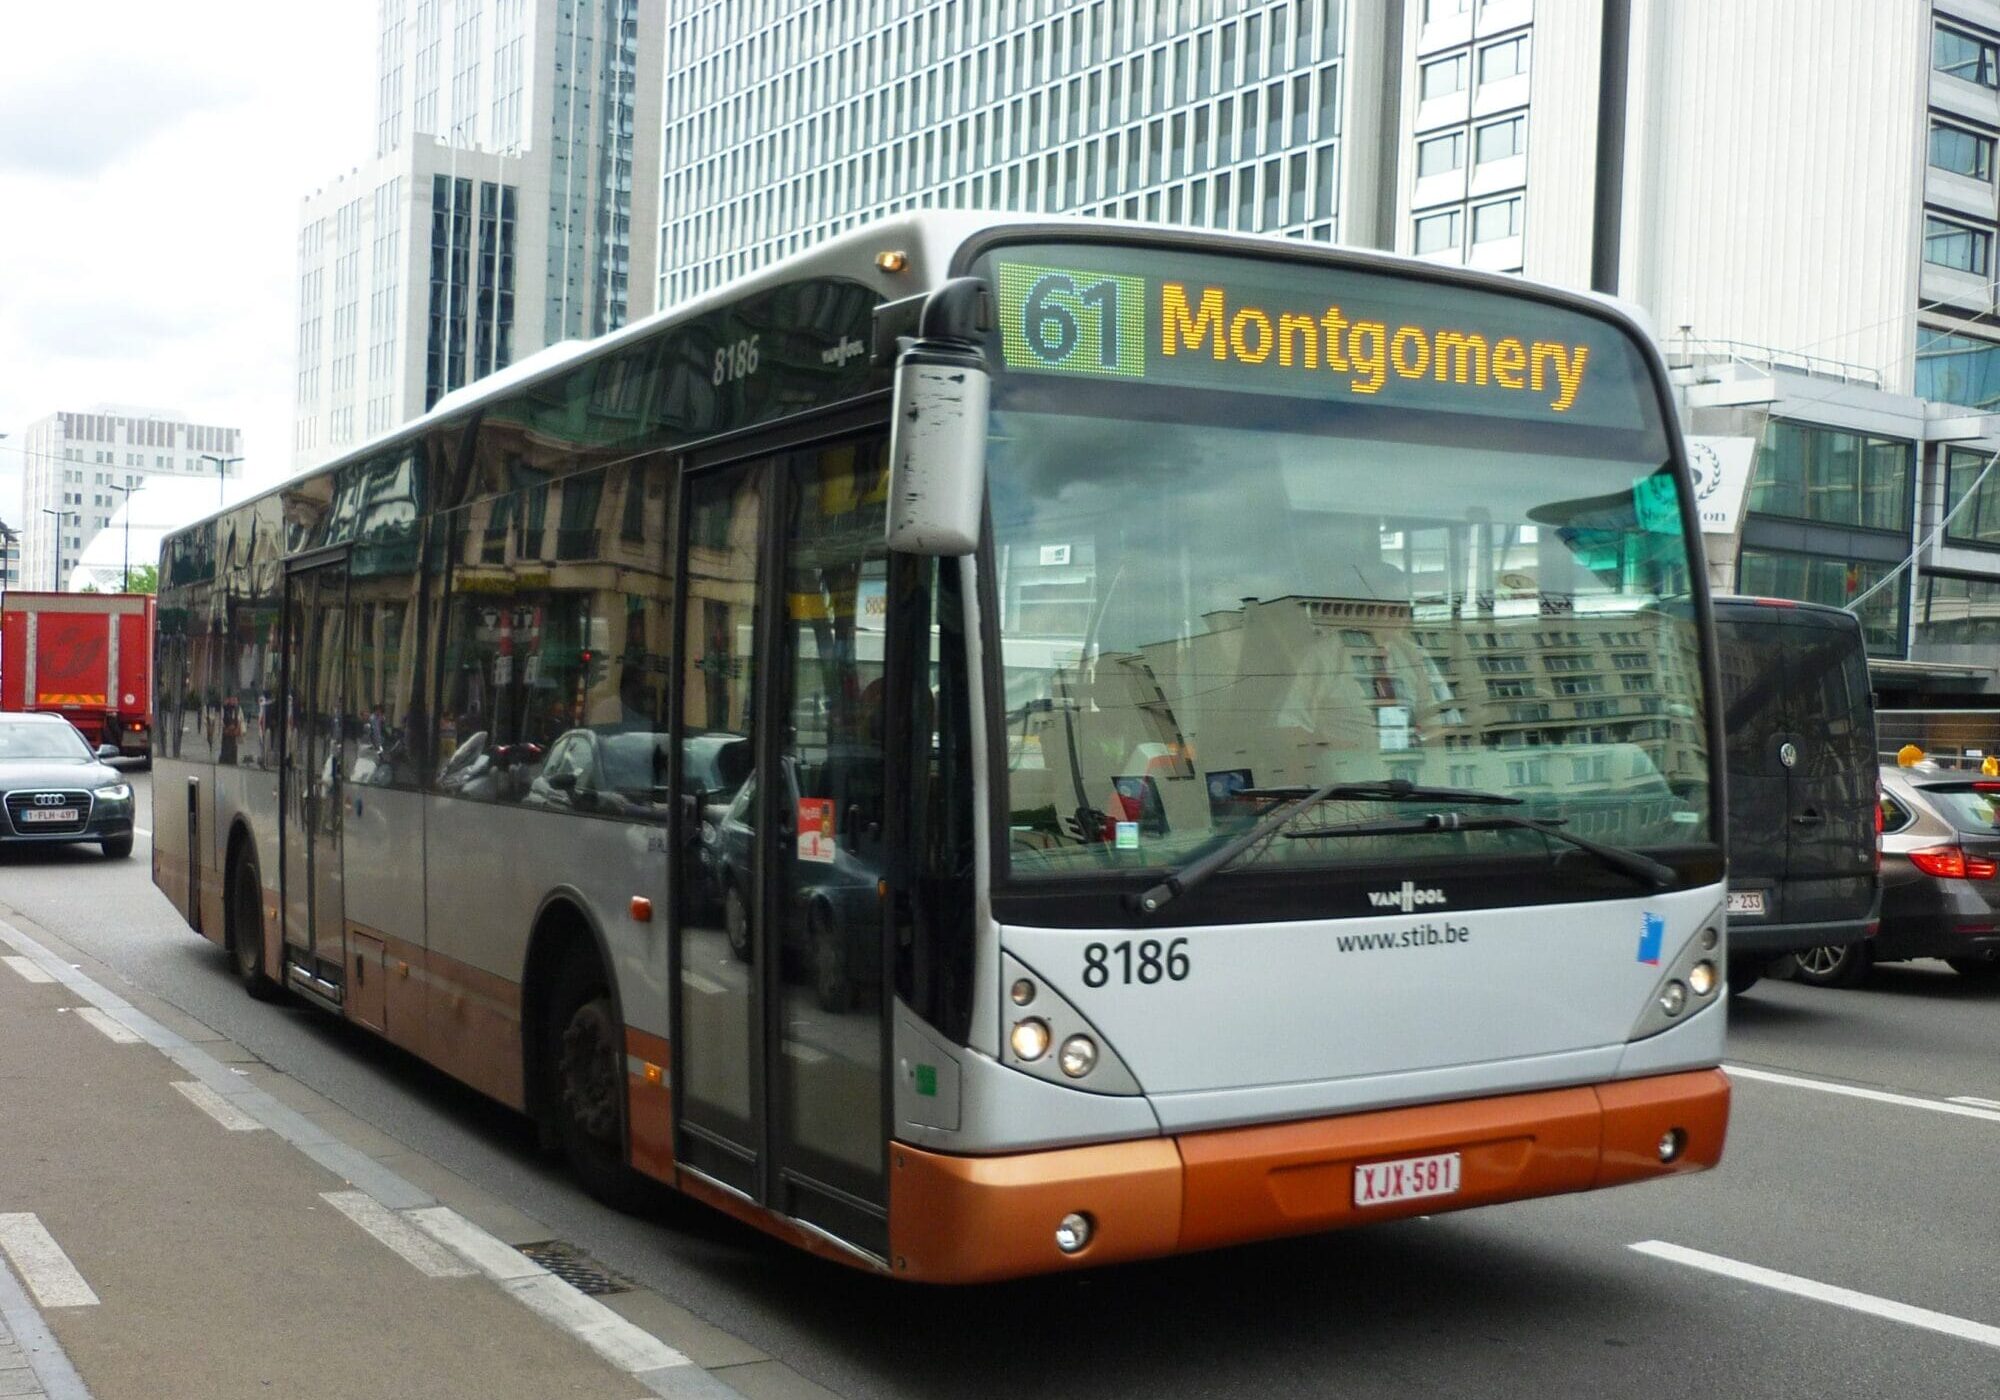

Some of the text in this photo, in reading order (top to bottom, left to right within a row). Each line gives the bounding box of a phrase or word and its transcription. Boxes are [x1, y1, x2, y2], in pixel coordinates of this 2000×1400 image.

[712, 333, 760, 386] 8186
[1024, 275, 1589, 412] 61 Montgomery
[1082, 937, 1191, 988] 8186
[1336, 922, 1470, 953] www.stib.be
